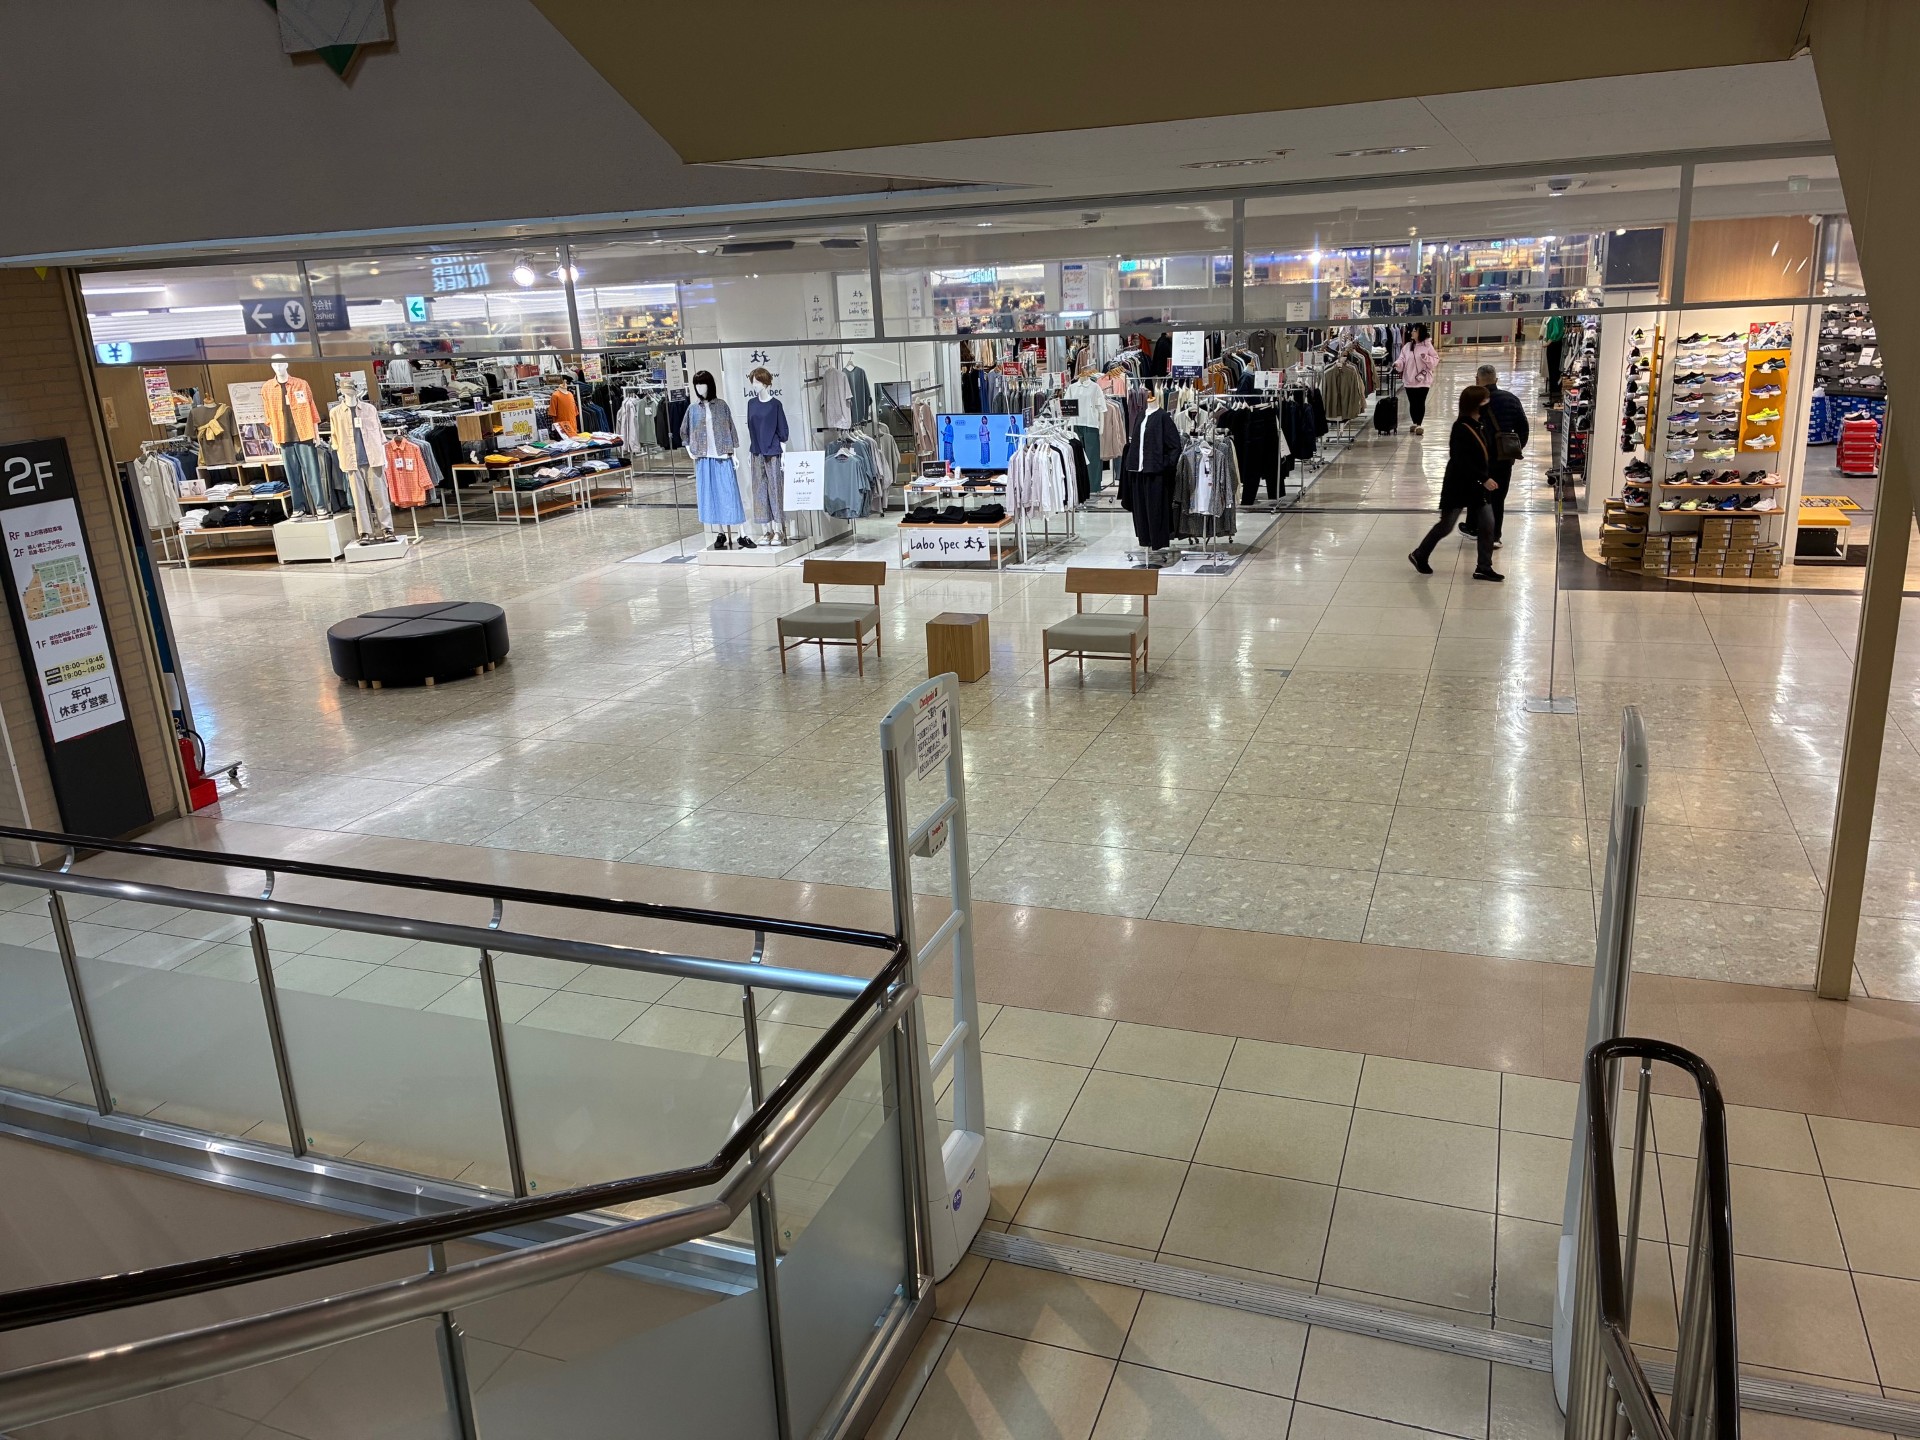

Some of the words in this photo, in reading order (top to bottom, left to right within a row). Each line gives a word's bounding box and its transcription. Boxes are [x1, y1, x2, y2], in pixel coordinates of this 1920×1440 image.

[313, 312, 335, 320] ashier
[4, 456, 54, 496] 2F
[805, 477, 815, 485] Spec
[9, 531, 20, 541] RF
[910, 536, 935, 550] Labo
[938, 536, 960, 555] Spec
[13, 548, 25, 558] 2F
[36, 640, 47, 649] 1F
[71, 686, 92, 700] 年中
[59, 693, 109, 718] 休まず営業
